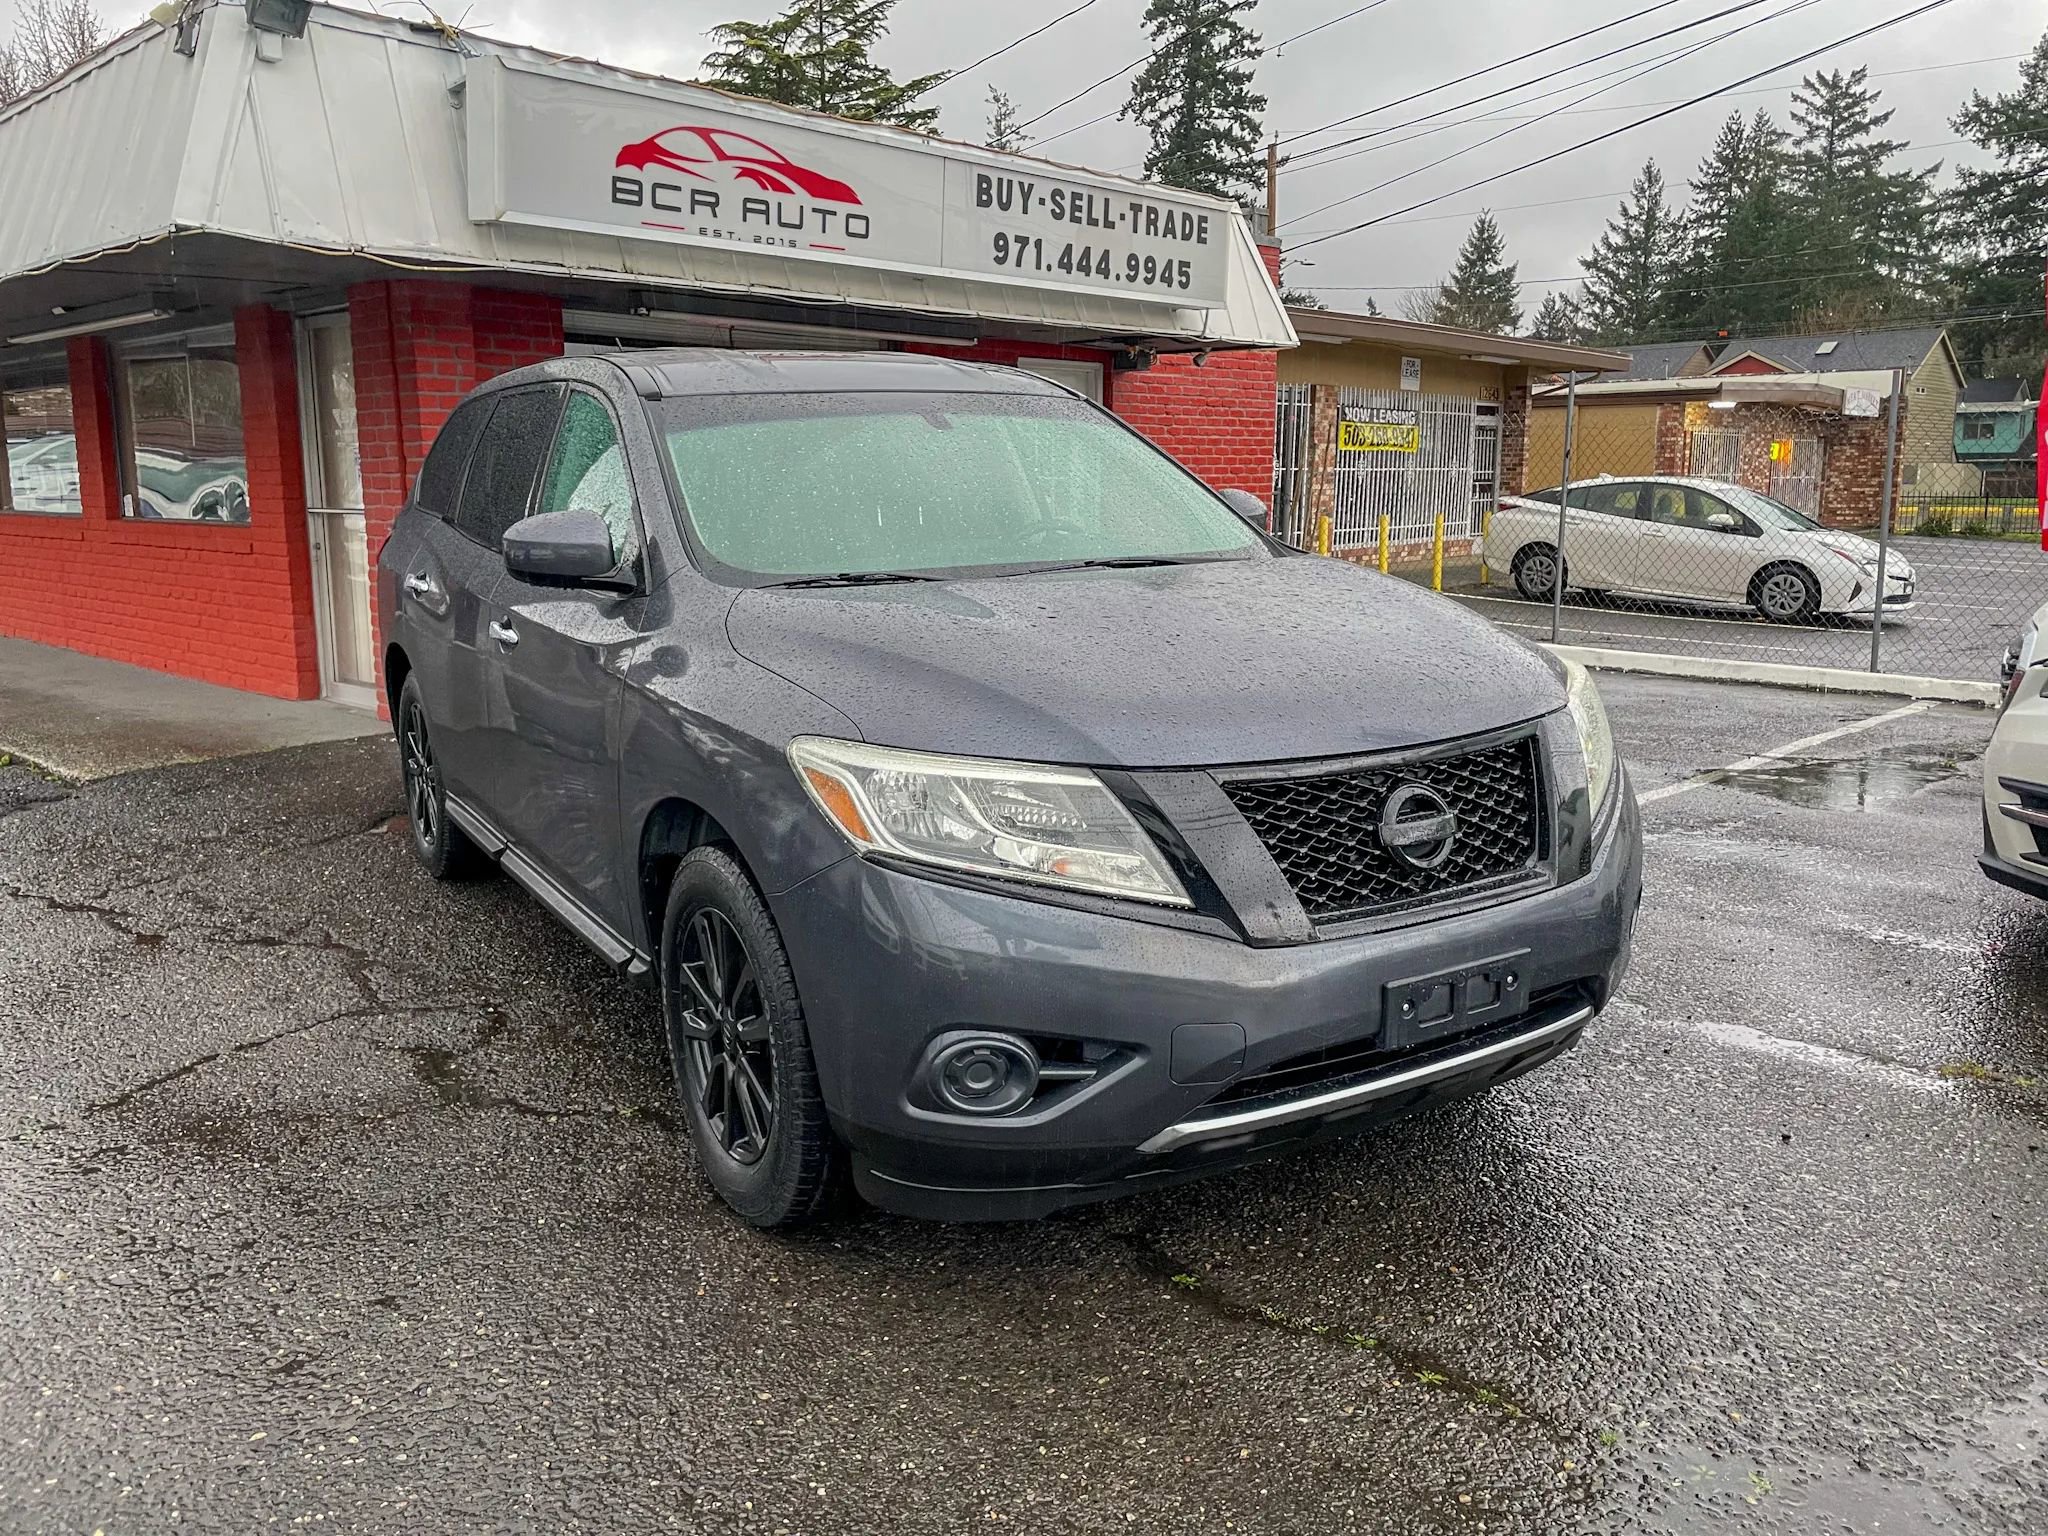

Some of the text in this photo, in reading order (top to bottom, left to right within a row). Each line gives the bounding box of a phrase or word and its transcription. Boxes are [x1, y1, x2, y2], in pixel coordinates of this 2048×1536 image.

[611, 175, 870, 239] BCR AUTO
[976, 173, 1208, 244] BUY-SELL-TRADE
[699, 227, 798, 248] EST. 2015
[993, 231, 1191, 290] 971.444.9945
[1402, 368, 1419, 379] LEASE
[1406, 359, 1416, 368] FOR
[1345, 406, 1416, 424] NOW LEASING
